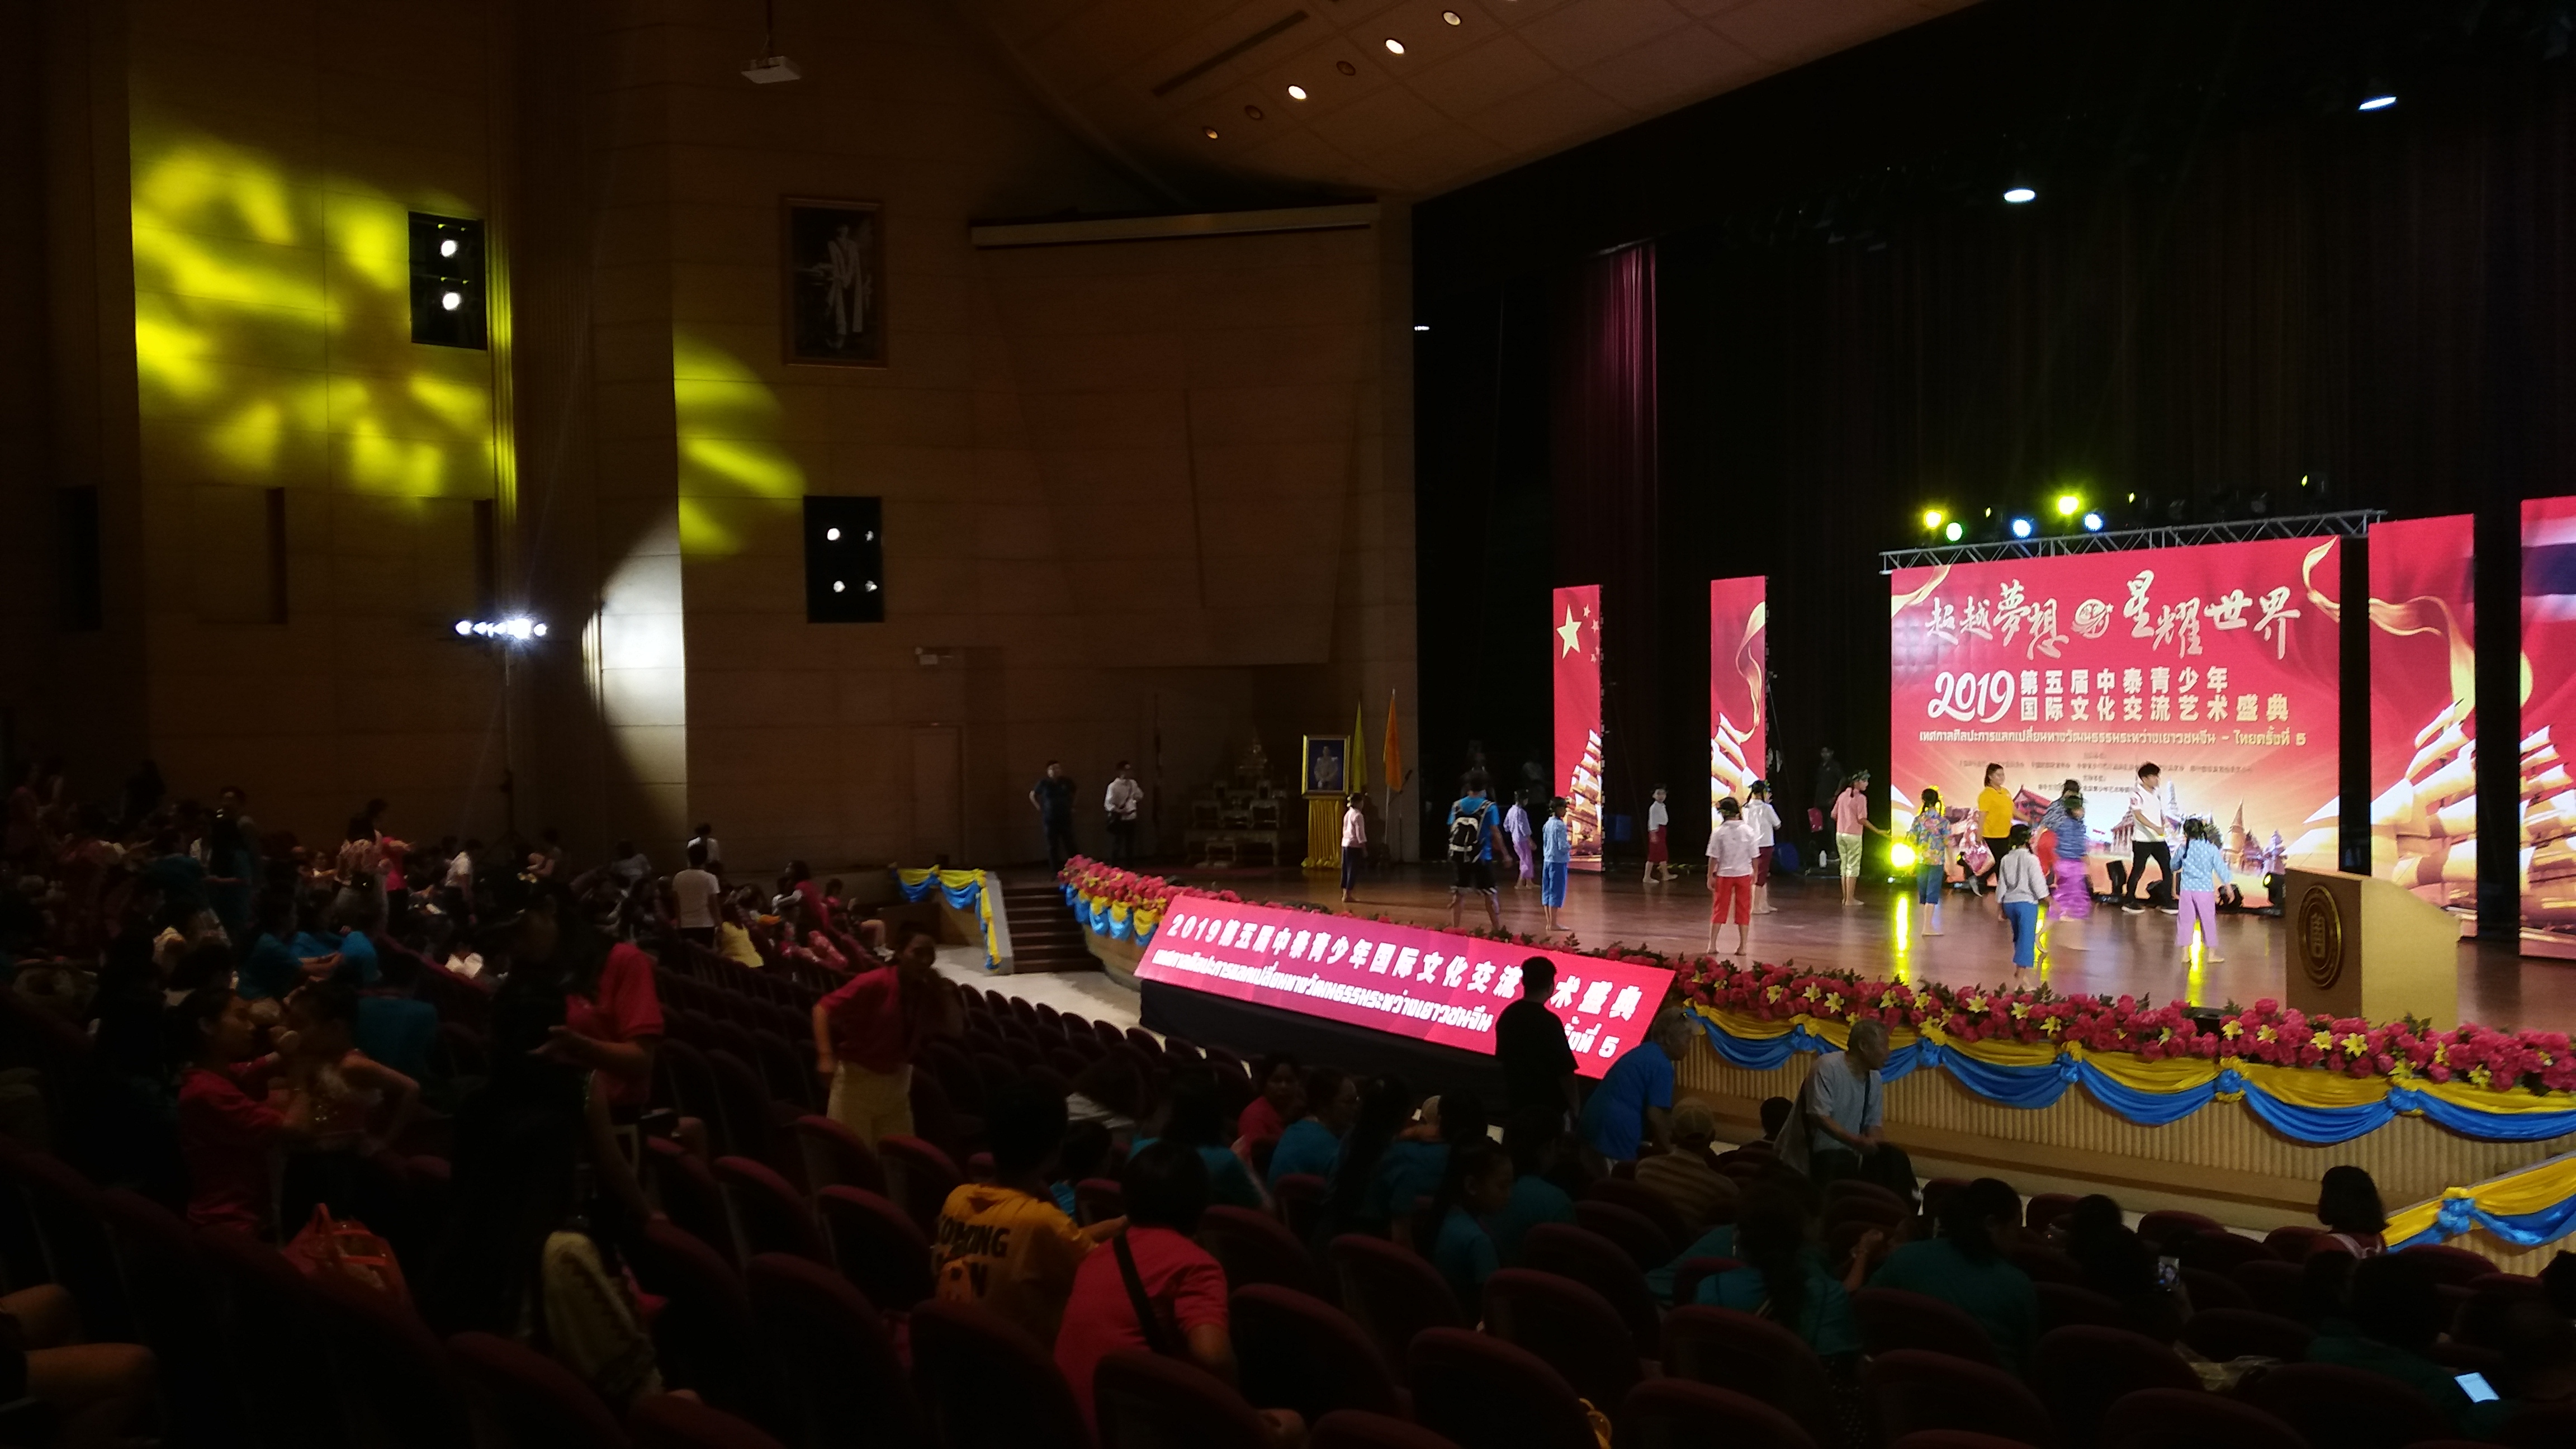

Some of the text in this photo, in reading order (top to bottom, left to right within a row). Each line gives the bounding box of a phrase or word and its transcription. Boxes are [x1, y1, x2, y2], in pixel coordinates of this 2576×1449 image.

[2123, 569, 2300, 660] 星耀世界
[1928, 666, 2228, 723] 2019 第五届中泰青少年
[2020, 694, 2289, 723] 国际文化交流艺术盛典
[1598, 1035, 1620, 1058] 5
